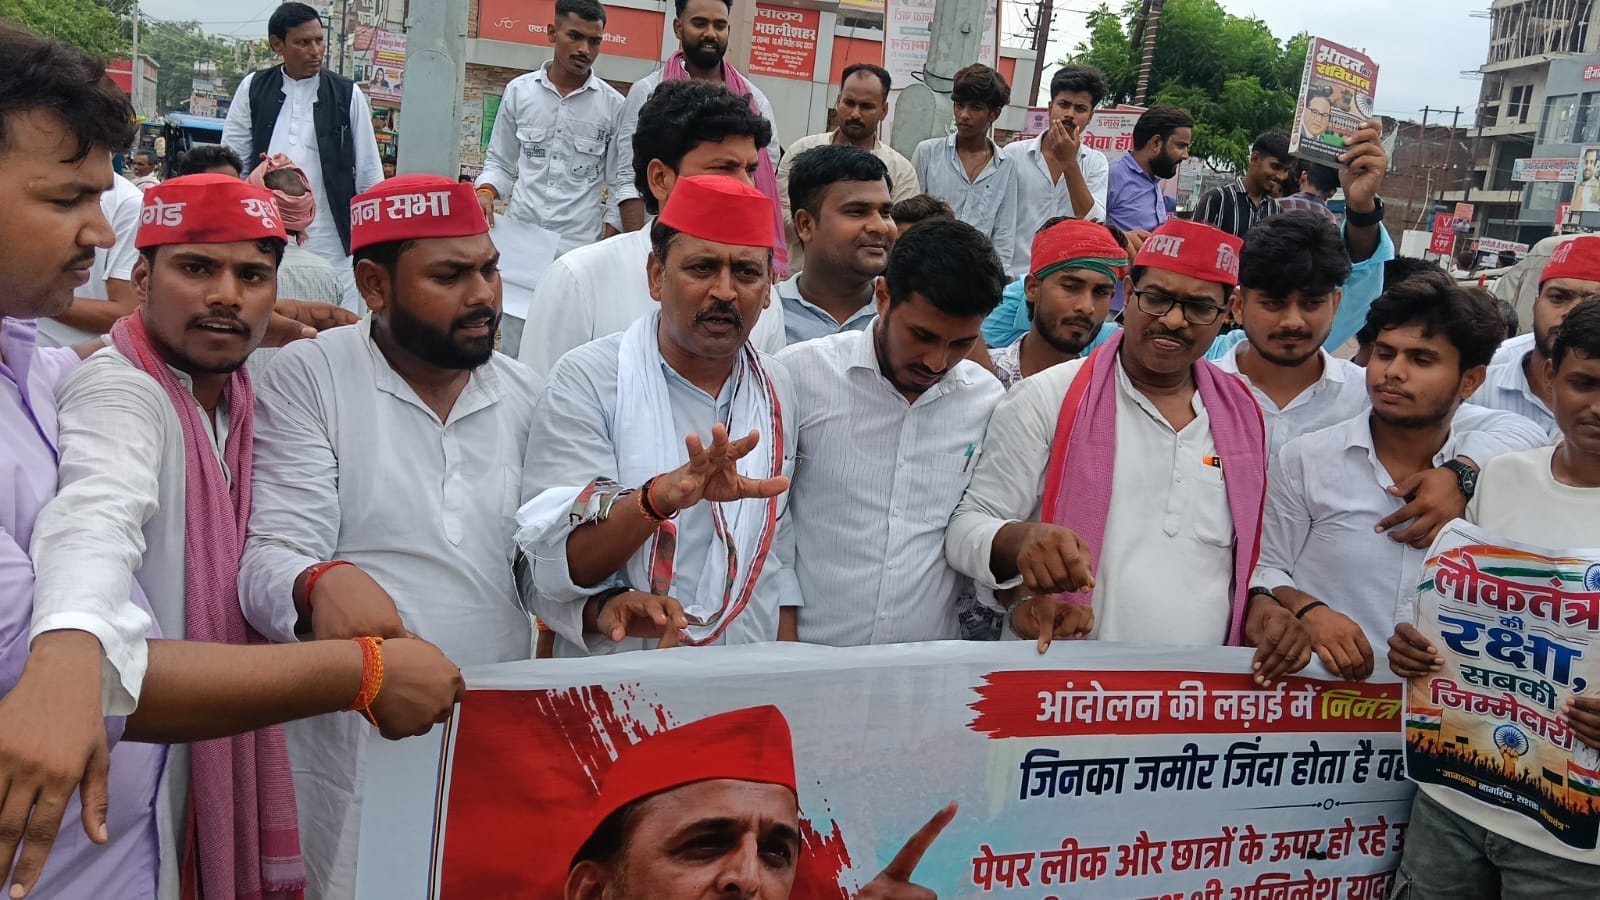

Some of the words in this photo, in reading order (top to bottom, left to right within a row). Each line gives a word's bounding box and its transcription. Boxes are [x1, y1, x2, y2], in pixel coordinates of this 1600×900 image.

[1316, 63, 1371, 90] संविधान
[1317, 44, 1365, 72] भारत
[1115, 132, 1135, 150] हॉ
[141, 196, 186, 227] गेड
[385, 191, 451, 220] सभा
[1433, 551, 1600, 631] लोकतंत्र
[1499, 615, 1524, 630] की
[1438, 614, 1588, 692] रक्षा,
[1036, 680, 1160, 723] आंदोलन
[1168, 680, 1204, 721] की
[1213, 682, 1282, 729] लड़ाई
[1288, 684, 1321, 720] में
[1321, 688, 1402, 720] निमंत्र
[1459, 663, 1558, 711] सबकी
[1429, 678, 1574, 750] जिम्मेदारी
[1019, 747, 1128, 800] जिनका
[1133, 742, 1220, 795] जमीर
[1222, 735, 1284, 789] जिंदा
[1291, 739, 1350, 786] होता
[1347, 740, 1376, 784] है
[972, 843, 1035, 891] पेपर
[1040, 836, 1110, 885] लीक
[1116, 829, 1169, 877] और
[1170, 825, 1239, 871] छात्रों
[1237, 823, 1267, 862] के
[1270, 825, 1327, 862] ऊपर
[1325, 817, 1357, 859] हो
[1357, 815, 1389, 857] रहे
